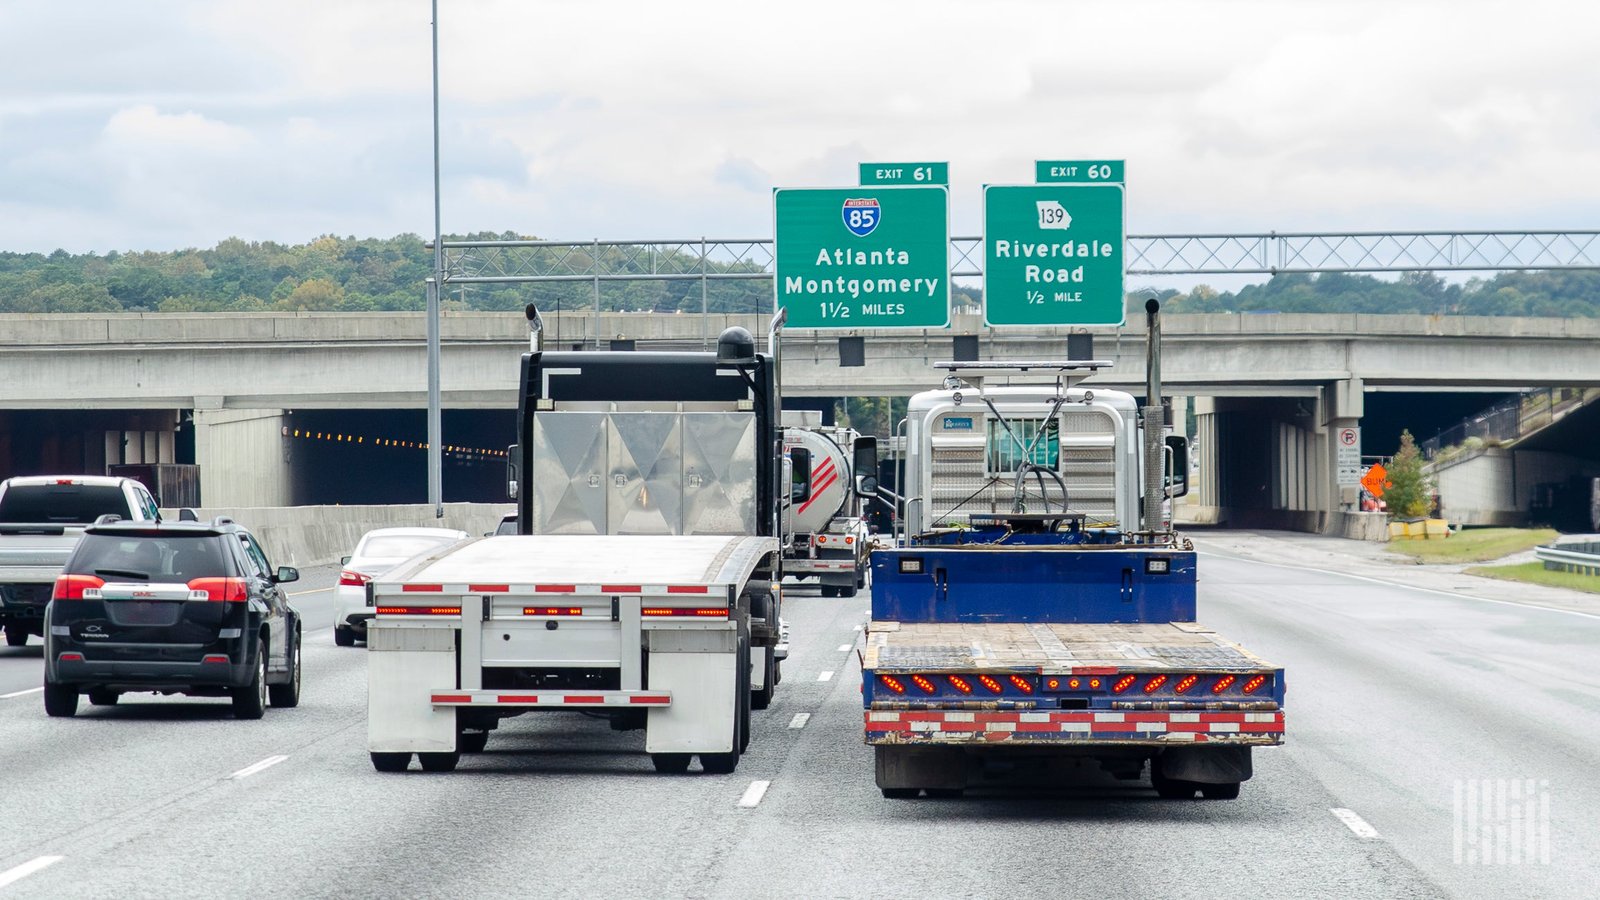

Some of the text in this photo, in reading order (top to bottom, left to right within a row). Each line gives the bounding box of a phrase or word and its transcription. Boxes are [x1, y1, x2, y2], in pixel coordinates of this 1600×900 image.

[876, 167, 933, 181] EXIT 61
[1051, 165, 1111, 179] EXIT 60
[850, 210, 874, 227] 85
[1041, 208, 1064, 223] 139
[816, 248, 909, 265] Atlanta
[996, 240, 1113, 257] Riverdale
[1025, 265, 1083, 282] Road
[785, 276, 938, 298] Montgomery
[1054, 292, 1082, 302] MILE
[862, 304, 905, 315] MILES
